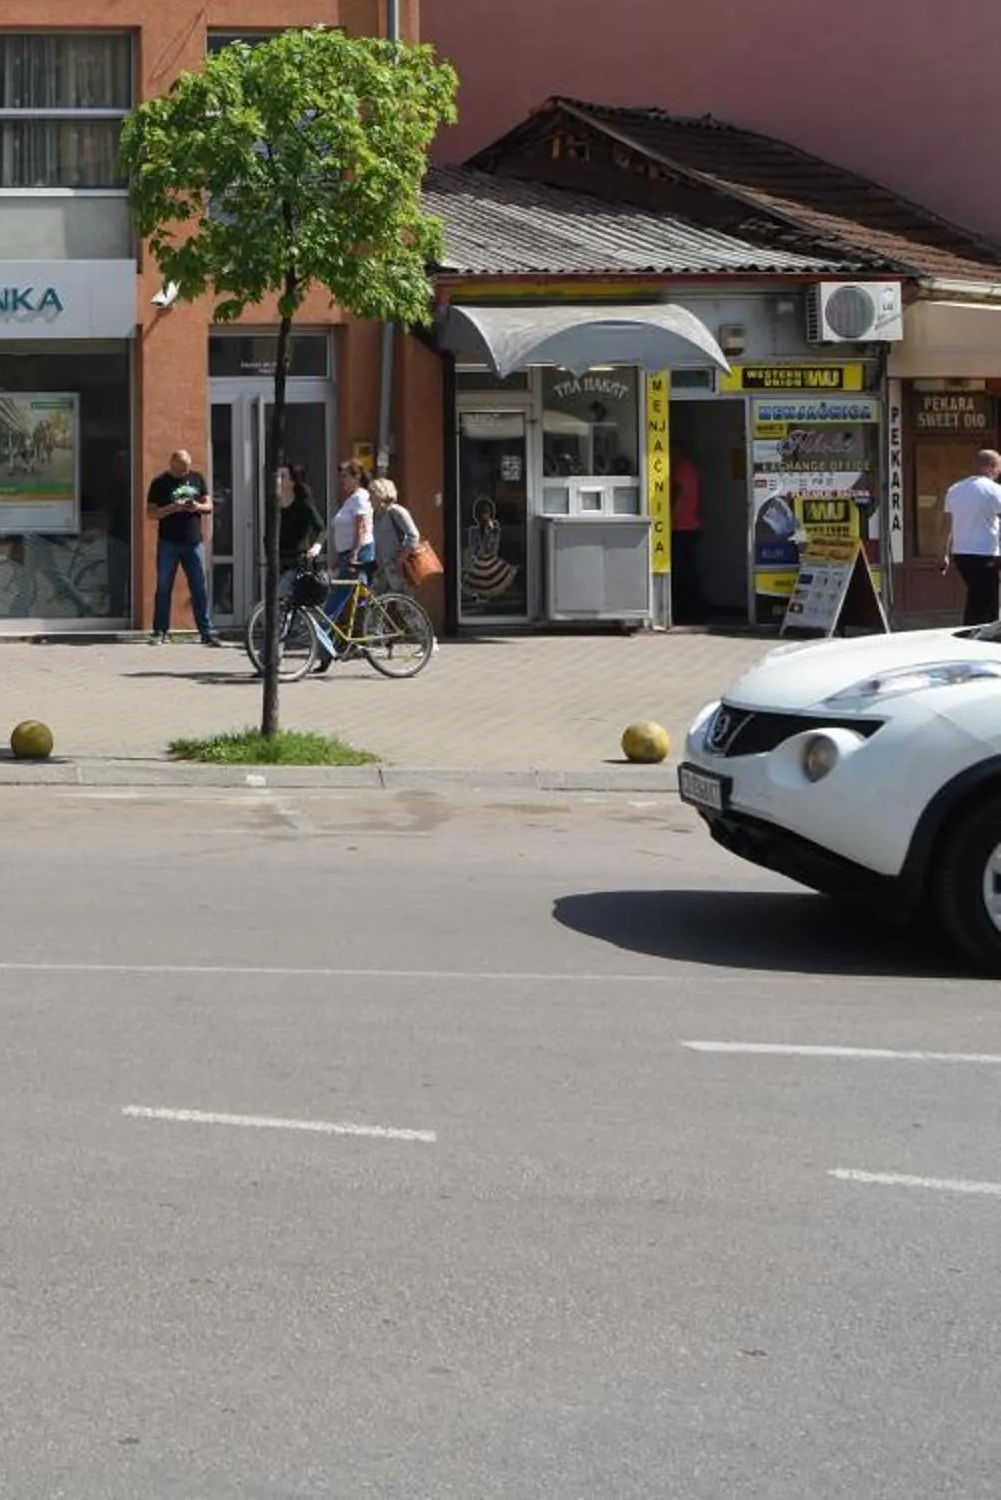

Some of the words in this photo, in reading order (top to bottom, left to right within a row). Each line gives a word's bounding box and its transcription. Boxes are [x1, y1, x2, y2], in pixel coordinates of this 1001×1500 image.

[745, 369, 802, 379] WESTERN
[764, 378, 802, 387] UNION
[829, 459, 872, 472] OFFICE
[890, 406, 901, 531] PEKARA
